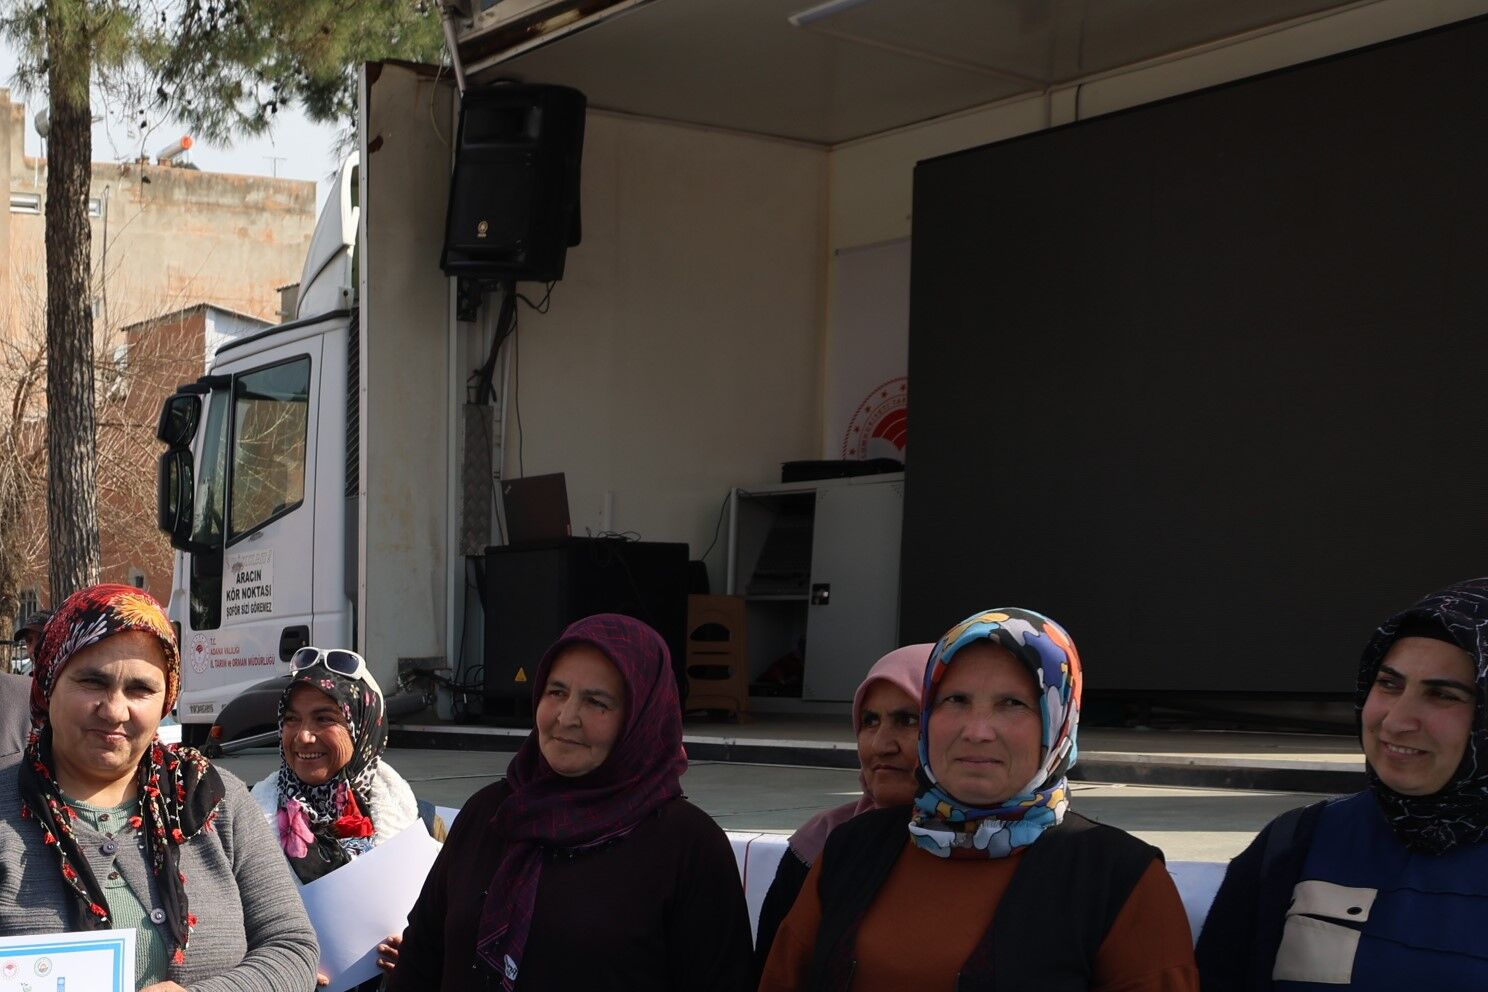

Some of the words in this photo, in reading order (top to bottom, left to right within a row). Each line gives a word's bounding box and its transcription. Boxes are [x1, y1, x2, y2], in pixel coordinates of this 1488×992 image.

[236, 569, 262, 585] ARACIN
[226, 587, 241, 602] KÖR
[242, 584, 272, 599] NOKTASI
[250, 600, 272, 614] GÖREMEZ
